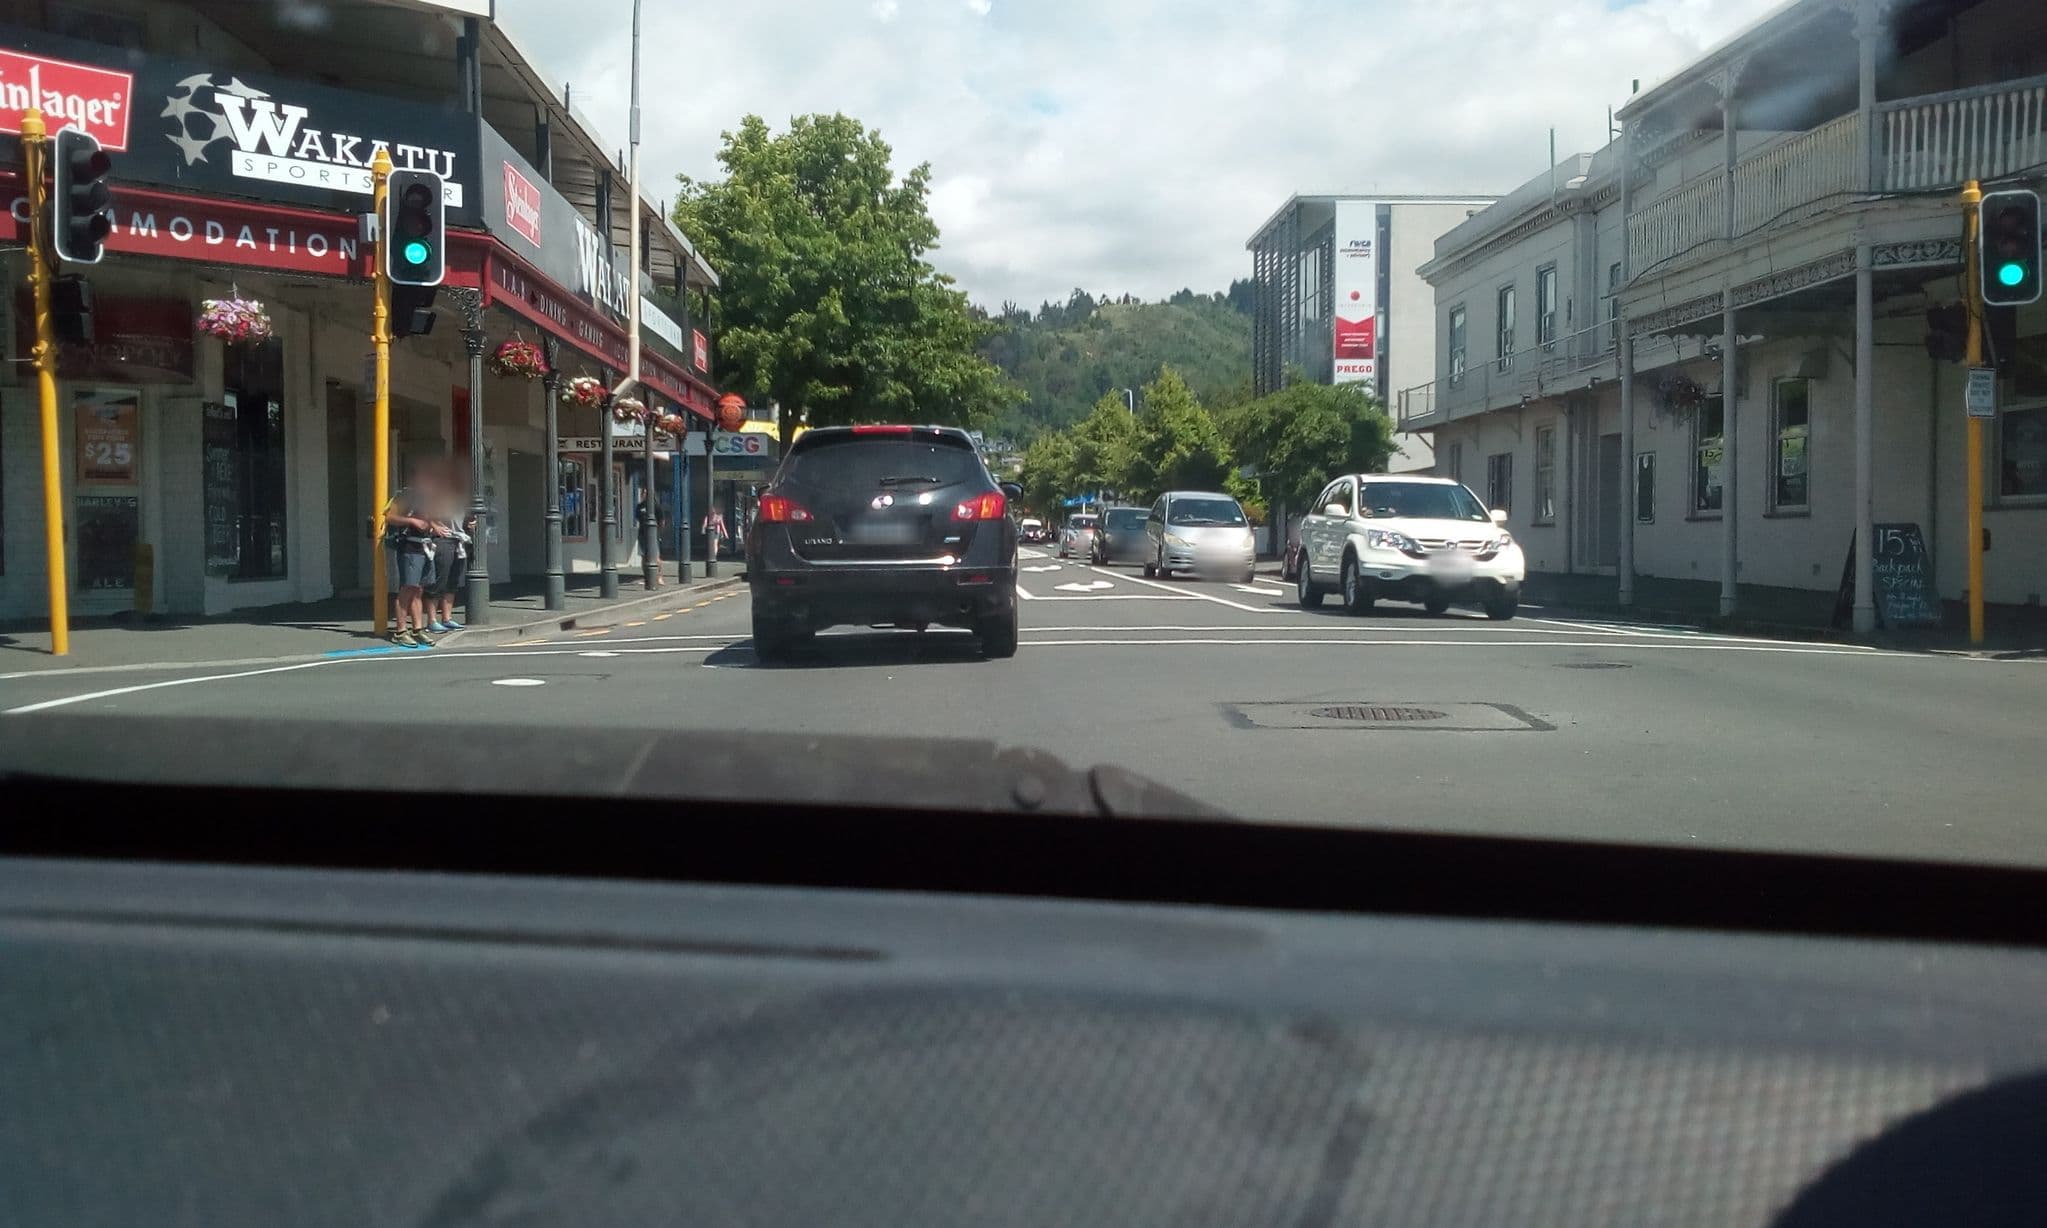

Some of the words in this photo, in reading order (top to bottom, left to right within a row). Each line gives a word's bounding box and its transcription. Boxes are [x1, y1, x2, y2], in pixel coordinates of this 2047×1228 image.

[215, 93, 456, 179] WAKATU
[244, 157, 373, 189] SPORTS
[1336, 365, 1373, 374] PREGO
[85, 442, 131, 465] $25
[714, 436, 759, 453] CSG
